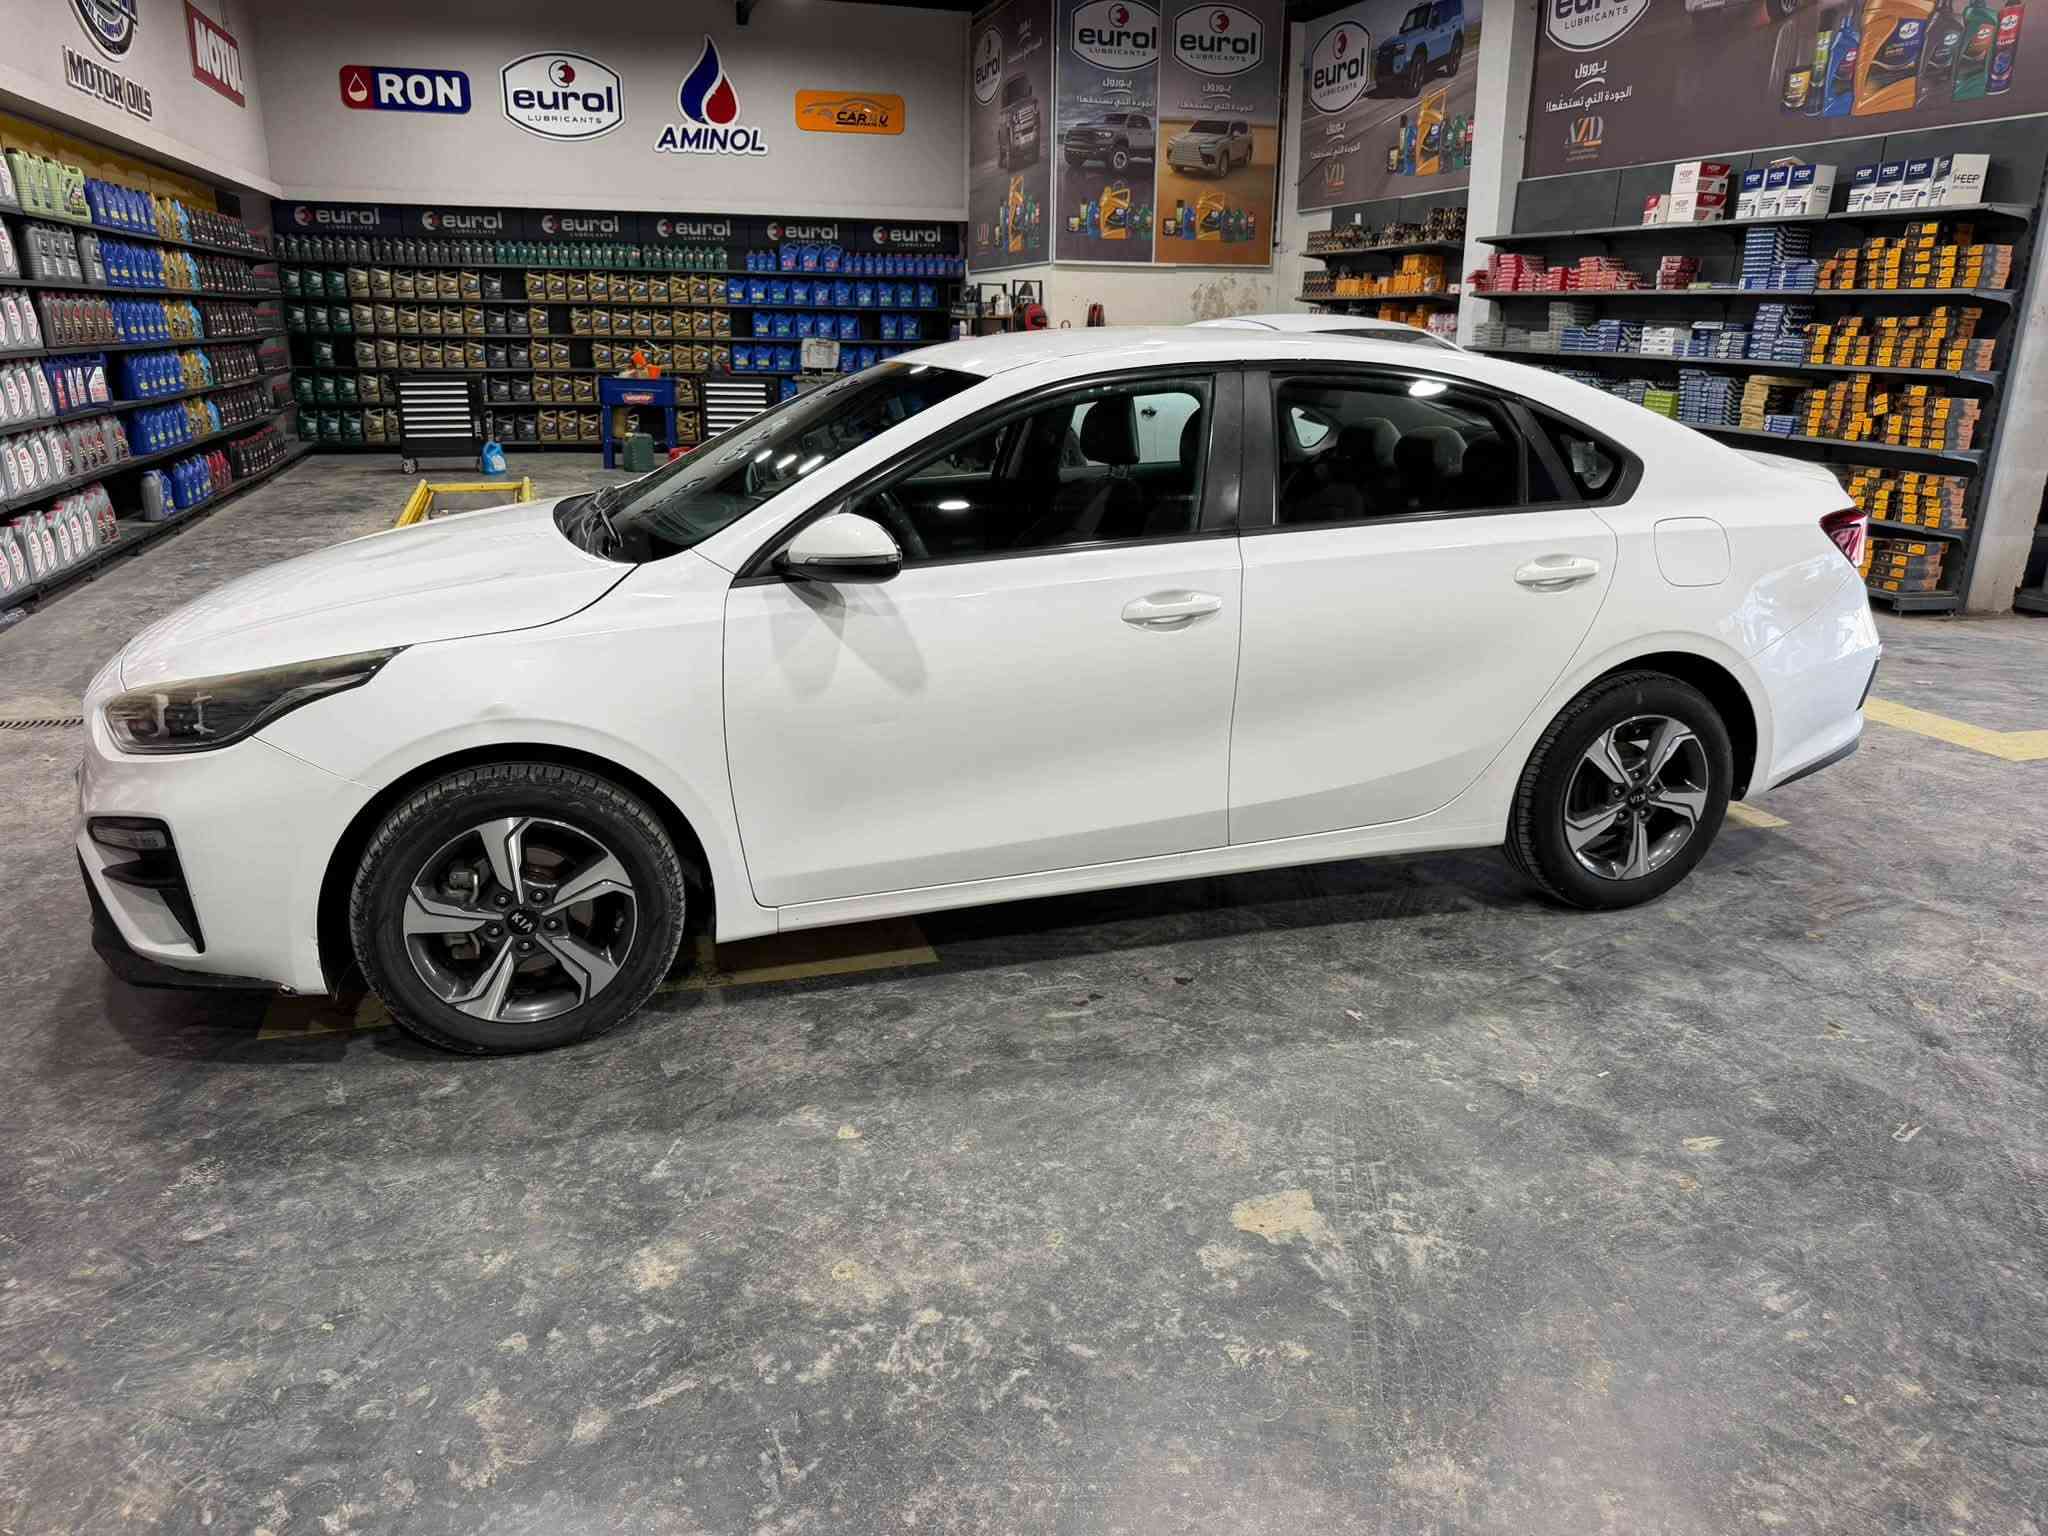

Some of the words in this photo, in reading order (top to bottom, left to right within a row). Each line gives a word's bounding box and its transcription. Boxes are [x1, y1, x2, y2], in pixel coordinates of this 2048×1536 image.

[1564, 5, 1629, 30] LUBRICANTS
[1079, 26, 1157, 49] eurol
[1180, 32, 1257, 55] eurol
[1314, 47, 1365, 89] eurol
[67, 48, 124, 105] MOTOR
[126, 79, 153, 117] OILS
[377, 73, 463, 108] RON
[512, 86, 614, 113] eurol
[526, 114, 603, 124] LUBRICANTS
[657, 127, 766, 152] AMINOL
[316, 207, 381, 225] eurol
[442, 211, 503, 229] eurol
[561, 215, 619, 232] eurol
[675, 219, 731, 236] eurol
[785, 223, 839, 239] eurol
[890, 225, 941, 242] eurol
[511, 912, 534, 933] KIA
